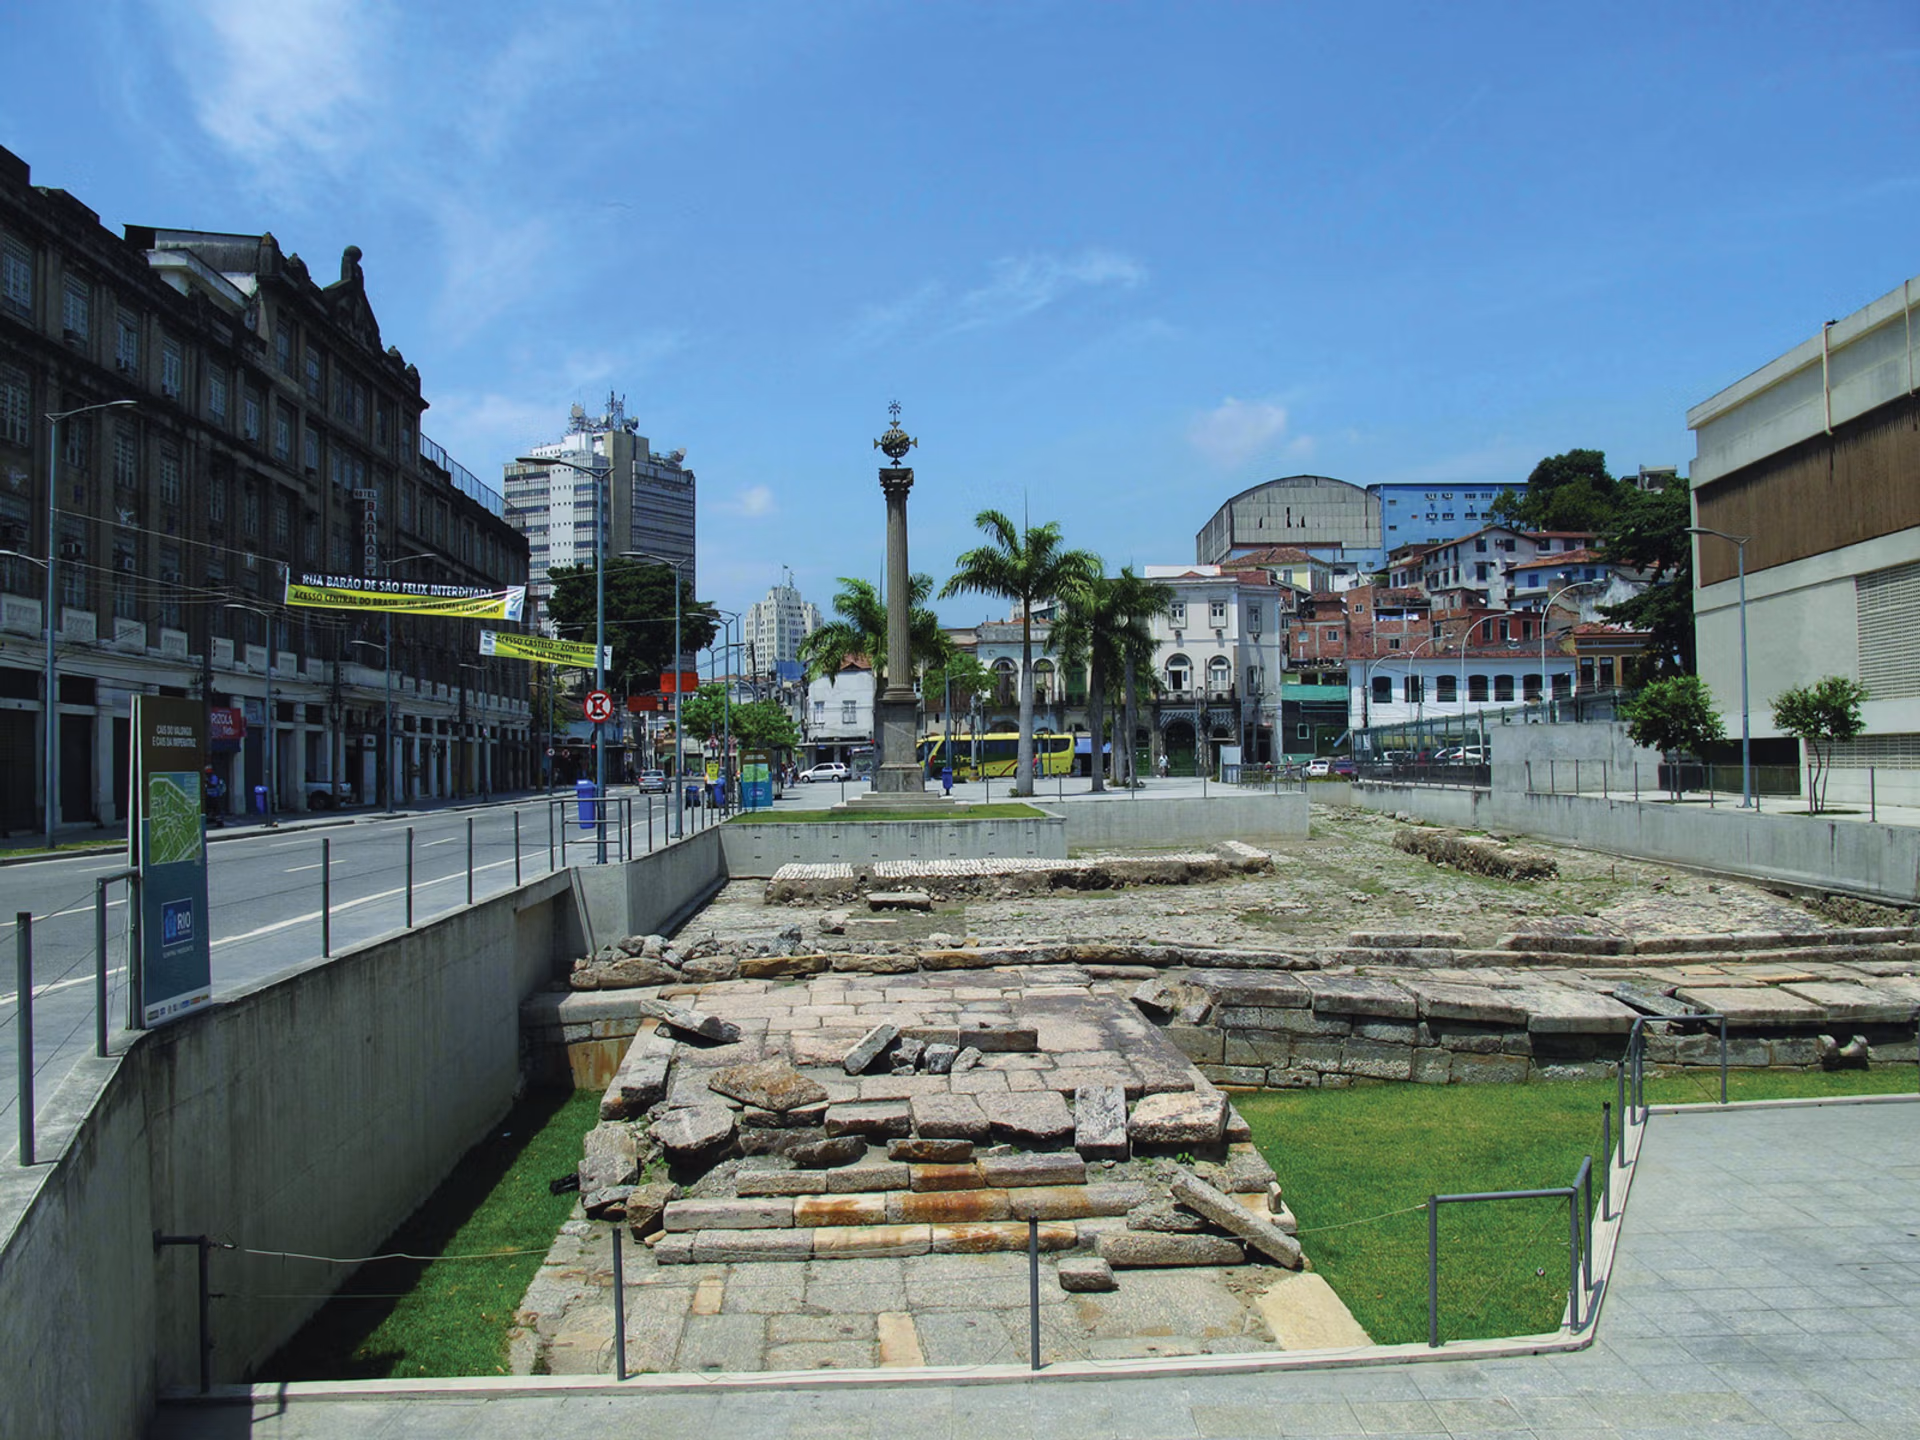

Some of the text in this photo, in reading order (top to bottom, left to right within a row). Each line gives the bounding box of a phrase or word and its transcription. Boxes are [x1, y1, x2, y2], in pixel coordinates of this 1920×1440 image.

[354, 490, 375, 498] HOTEL
[302, 573, 493, 599] RUA BARÃO DE SÃO FELIX INTERDITADA
[294, 590, 322, 602] ACESSO
[325, 593, 357, 605] CENTRAL
[359, 596, 371, 606] DO
[373, 597, 398, 607] BRASIL
[497, 634, 522, 646] ACESSO
[524, 638, 554, 650] CASTELO
[561, 643, 580, 654] ZONA
[177, 911, 191, 930] RIO
